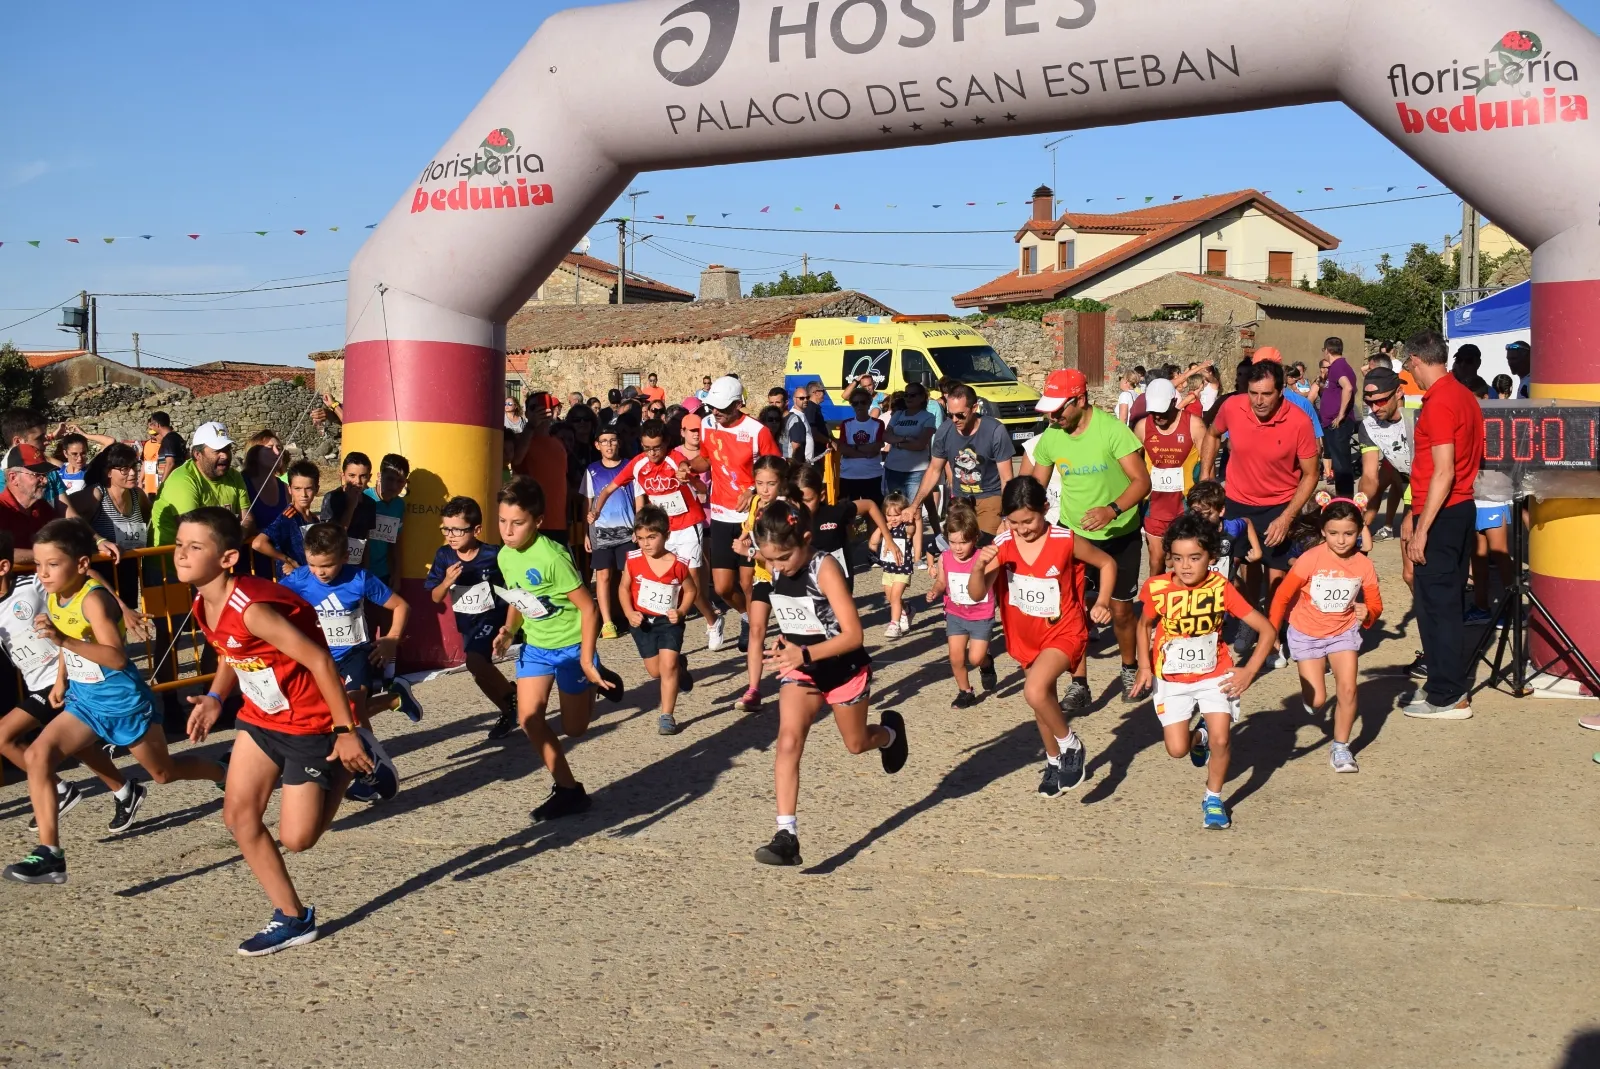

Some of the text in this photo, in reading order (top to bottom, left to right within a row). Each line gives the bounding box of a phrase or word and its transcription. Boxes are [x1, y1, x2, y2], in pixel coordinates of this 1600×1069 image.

[1387, 51, 1579, 97] floristería
[665, 45, 1240, 135] PALACIO DE SAN ESTEBAN
[1396, 87, 1589, 134] bedunia
[411, 178, 554, 214] bedunia
[810, 336, 892, 346] AMBULANCIA ASISTENCIAL
[1160, 476, 1172, 485] 10
[377, 523, 393, 534] 170
[124, 531, 140, 541] 119
[649, 591, 673, 605] 213
[1018, 588, 1045, 604] 169
[1323, 588, 1350, 601] 202
[776, 607, 807, 621] 158
[326, 624, 352, 637] 187
[11, 645, 37, 662] 171
[1177, 647, 1206, 661] 191
